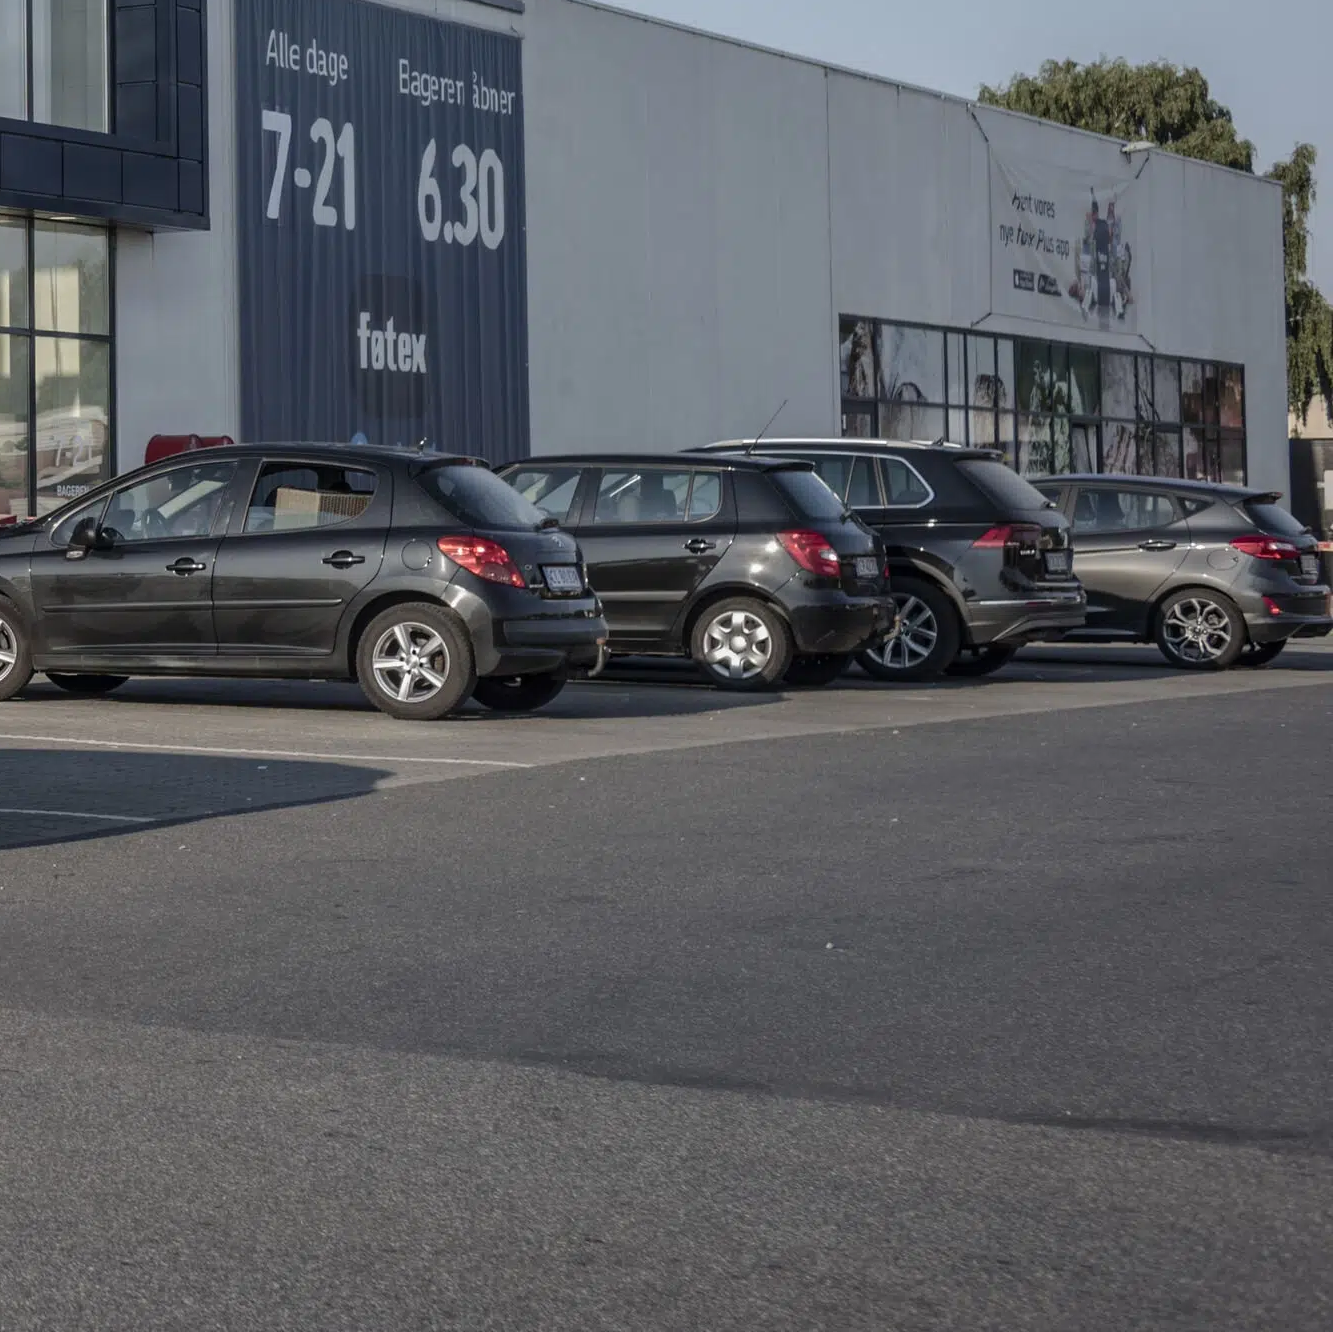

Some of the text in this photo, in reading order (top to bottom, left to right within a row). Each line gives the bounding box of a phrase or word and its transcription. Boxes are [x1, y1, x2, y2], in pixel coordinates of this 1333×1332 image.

[266, 29, 348, 86] Alle dage
[399, 58, 515, 116] Bageren åbner
[262, 110, 355, 231] 7-21
[418, 138, 505, 250] 6.30
[1034, 197, 1055, 219] vores
[999, 223, 1014, 247] nye
[1055, 238, 1070, 261] app
[357, 311, 427, 373] føtex
